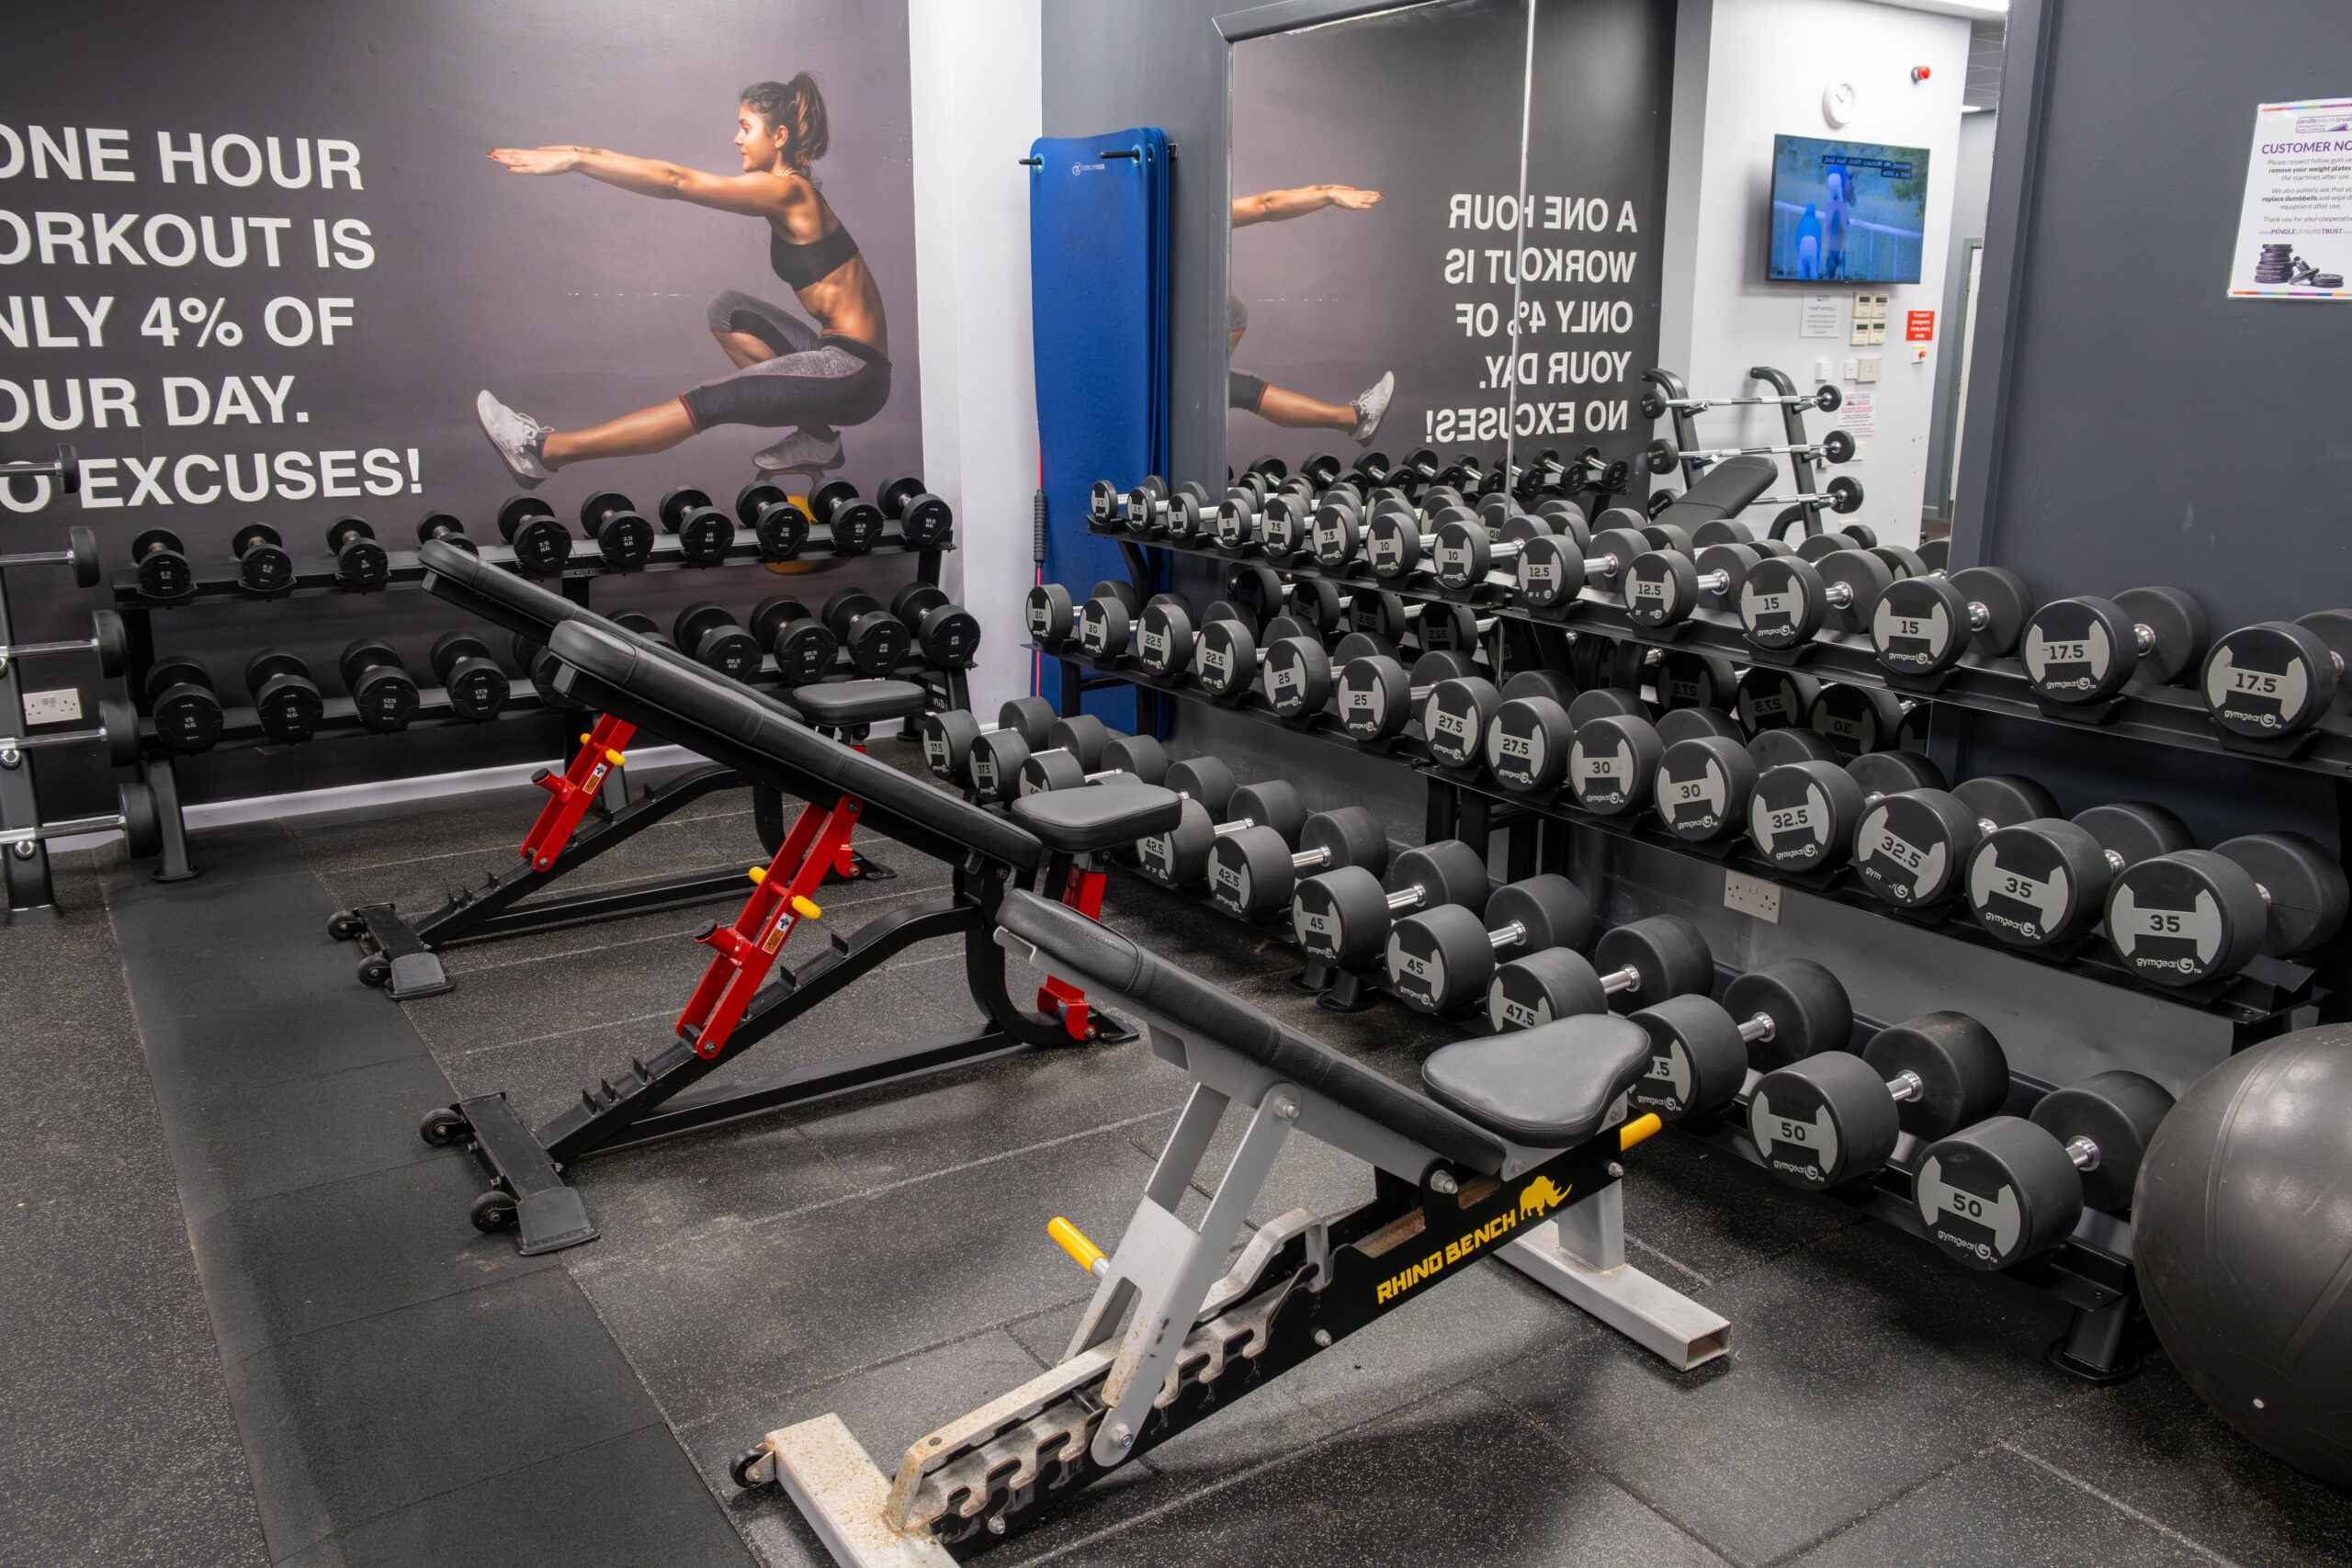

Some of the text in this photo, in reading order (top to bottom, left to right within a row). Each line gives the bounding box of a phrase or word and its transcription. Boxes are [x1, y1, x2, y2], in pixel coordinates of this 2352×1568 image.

[2261, 141, 2331, 154] CUSTOMER
[157, 131, 365, 190] HOUR
[314, 220, 375, 270] IS
[141, 296, 243, 347] 4%
[264, 296, 355, 346] OF
[163, 376, 309, 426] DAY.
[79, 448, 423, 509] EXCUSES!
[1272, 523, 1281, 531] 7.5
[1324, 532, 1335, 541] 7.5
[1380, 541, 1390, 551] 10
[1448, 551, 1458, 561] 10
[1529, 567, 1550, 578] 12.5
[1638, 583, 1661, 596] 12.5
[1763, 597, 1779, 610] 15
[1089, 624, 1098, 634] 20
[1900, 620, 1918, 635] 15
[1146, 634, 1162, 648] 22.5
[1205, 651, 1224, 666] 22.5
[2049, 644, 2084, 660] 17.5
[1278, 672, 1291, 684] 25
[2234, 673, 2277, 694] 17.5
[1354, 694, 1367, 705] 25
[1439, 715, 1463, 733] 27.5
[1502, 739, 1529, 755] 27.5
[1592, 761, 1611, 774] 30
[1680, 784, 1701, 799] 30
[1771, 809, 1808, 829] 32.5
[1147, 838, 1164, 855] 42.5
[1881, 835, 1922, 869] 32.5
[1218, 868, 1239, 888] 42.5
[2005, 877, 2032, 899] 35
[1310, 917, 1324, 931] 45
[2149, 914, 2181, 933] 35
[1407, 958, 1424, 975] 45
[1506, 1004, 1535, 1026] 47.5
[1781, 1122, 1805, 1141] 50
[1953, 1195, 1982, 1218] 50
[1376, 1209, 1516, 1304] RHINO BENCH
